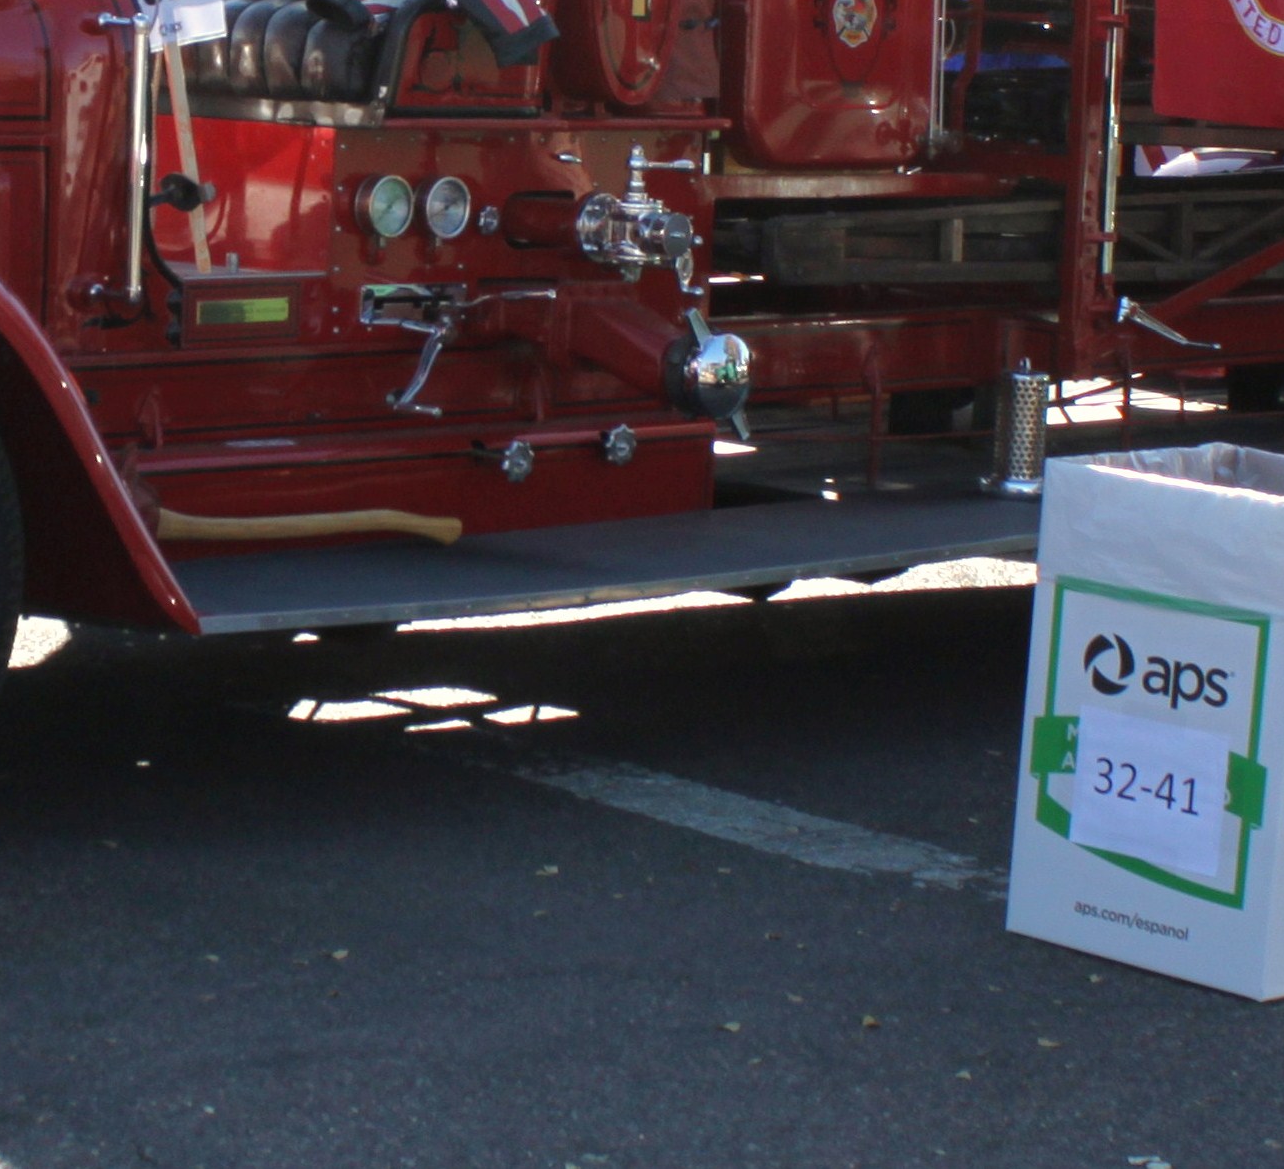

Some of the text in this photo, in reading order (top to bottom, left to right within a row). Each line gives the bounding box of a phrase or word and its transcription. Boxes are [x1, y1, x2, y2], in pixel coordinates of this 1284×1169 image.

[1142, 656, 1228, 710] aps
[1093, 756, 1200, 816] 32-41
[1073, 900, 1189, 941] aps.com/espanol
